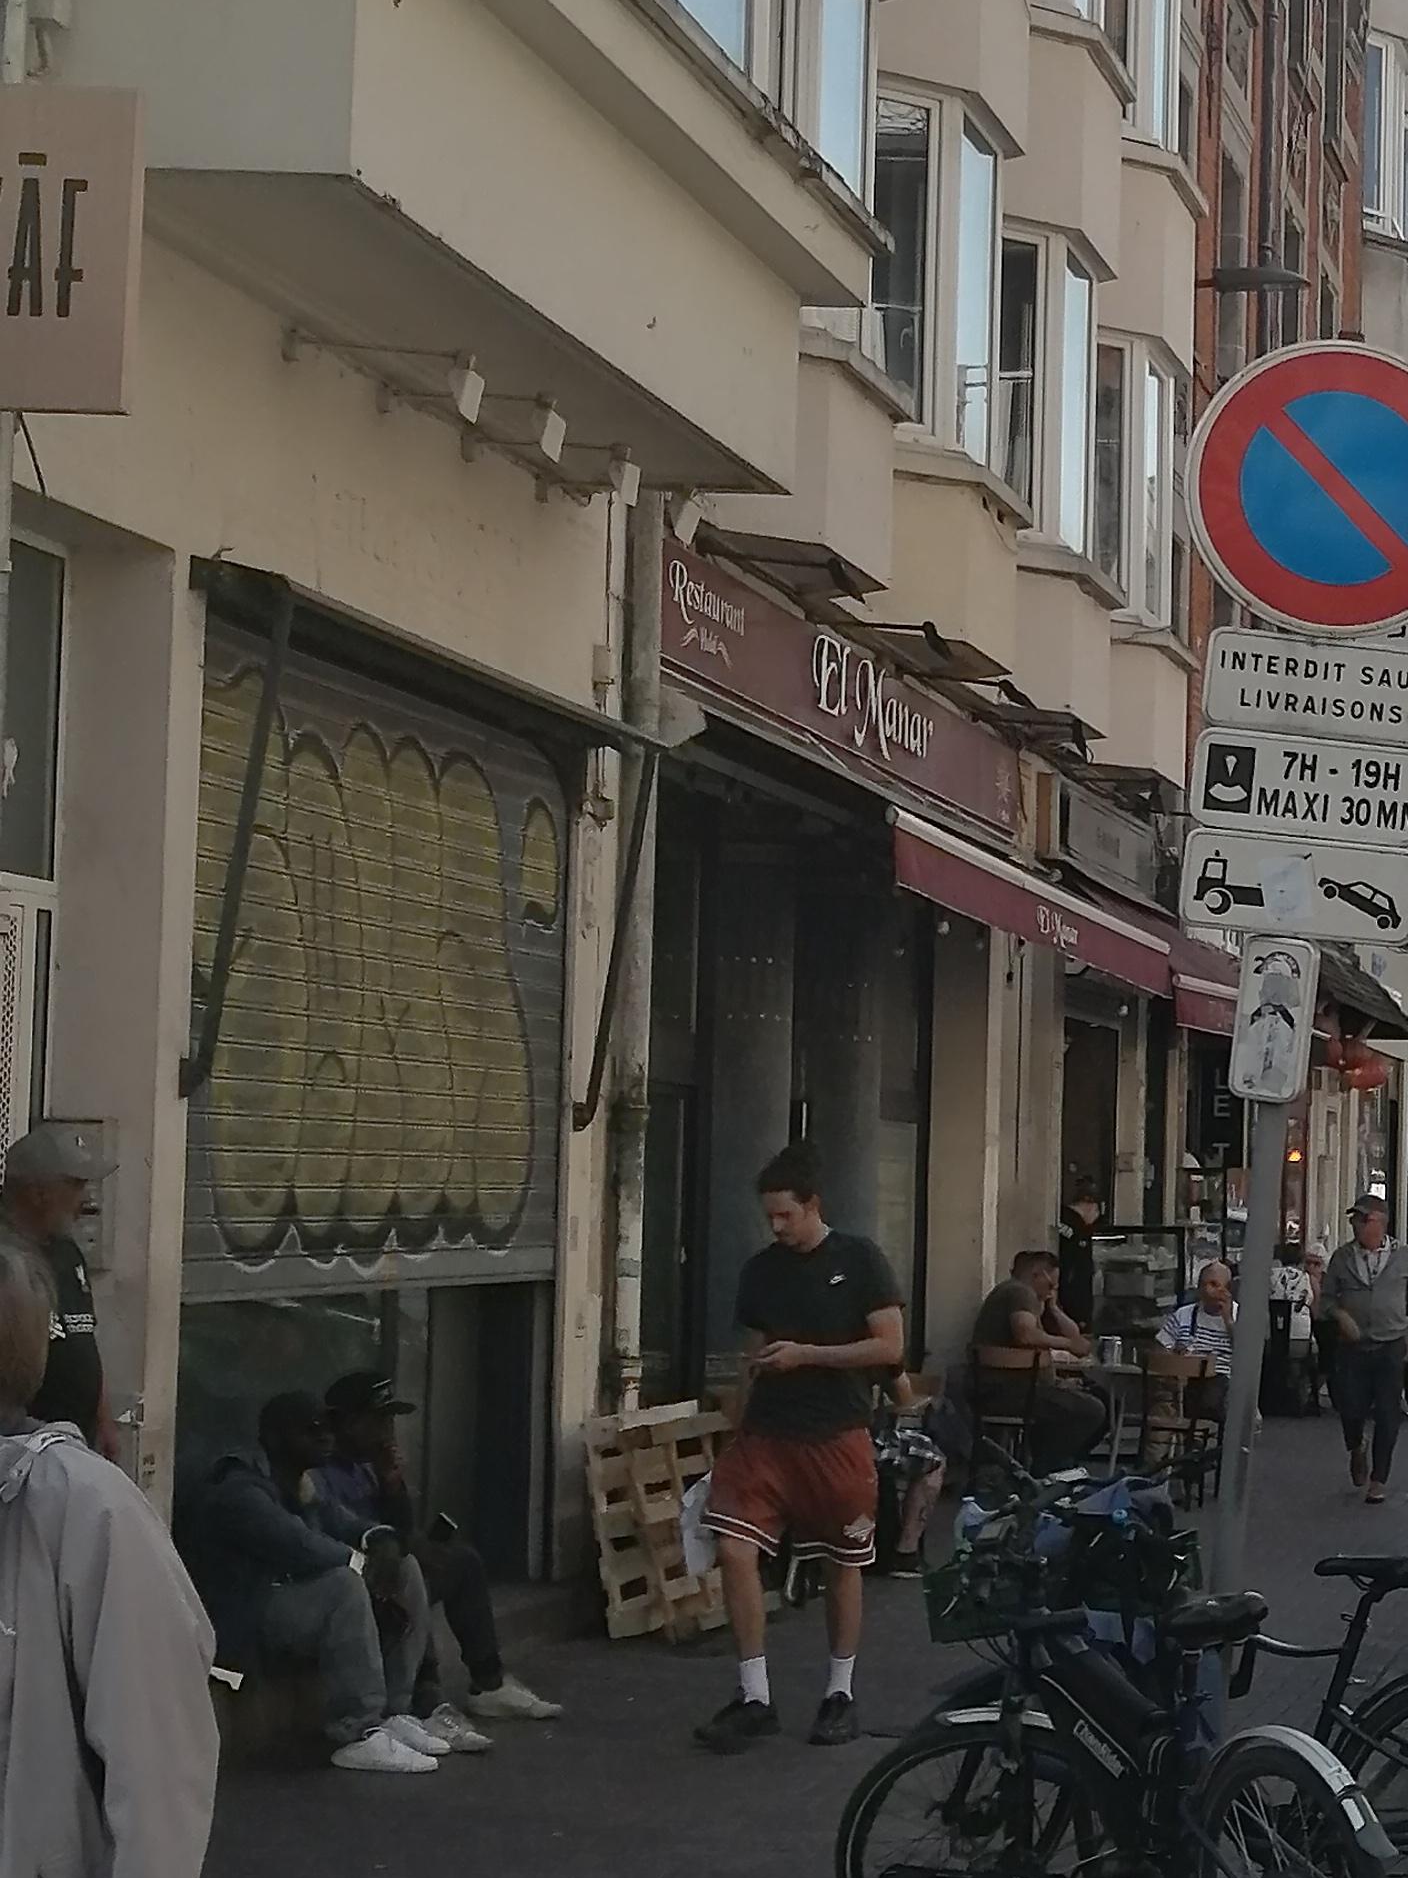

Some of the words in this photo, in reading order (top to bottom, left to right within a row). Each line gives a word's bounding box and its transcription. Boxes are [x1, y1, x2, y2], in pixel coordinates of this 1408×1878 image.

[669, 560, 745, 636] Restaurant
[1220, 649, 1346, 682] INTERDIT
[813, 635, 851, 717] El
[854, 659, 934, 761] Manar
[1239, 688, 1403, 724] LIVRAISONS
[1282, 750, 1318, 783] 7H
[1351, 758, 1401, 791] 19H
[1257, 787, 1329, 823] MAXI
